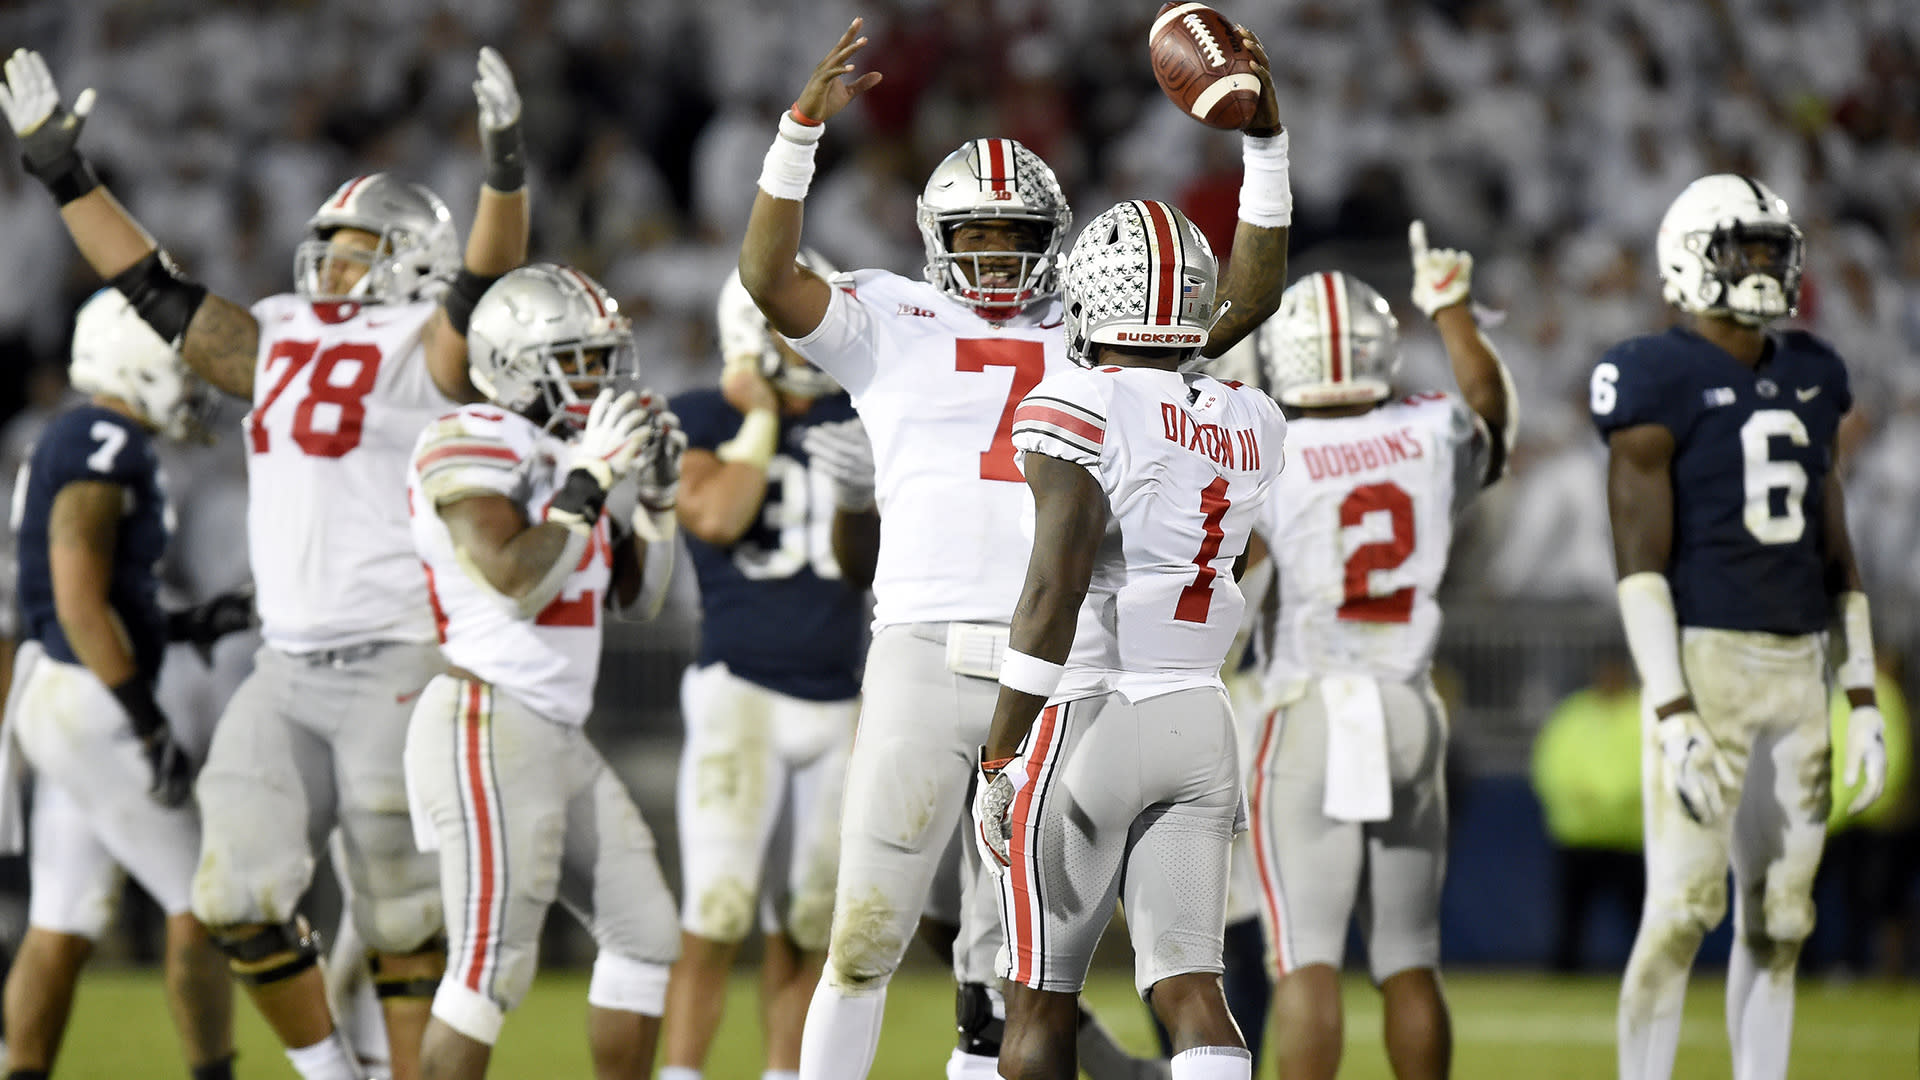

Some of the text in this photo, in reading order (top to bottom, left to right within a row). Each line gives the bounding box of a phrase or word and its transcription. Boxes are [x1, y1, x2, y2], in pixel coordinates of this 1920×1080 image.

[1117, 331, 1202, 344] BUCKEYES
[250, 337, 382, 460] 78
[955, 338, 1046, 483] 7
[1161, 402, 1260, 472] DIXON III
[1590, 362, 1620, 416] 6
[86, 420, 129, 473] 7
[1302, 427, 1424, 482] DOBBINS
[1739, 409, 1810, 545] 6
[1173, 476, 1231, 624] 1
[1336, 480, 1417, 624] 2
